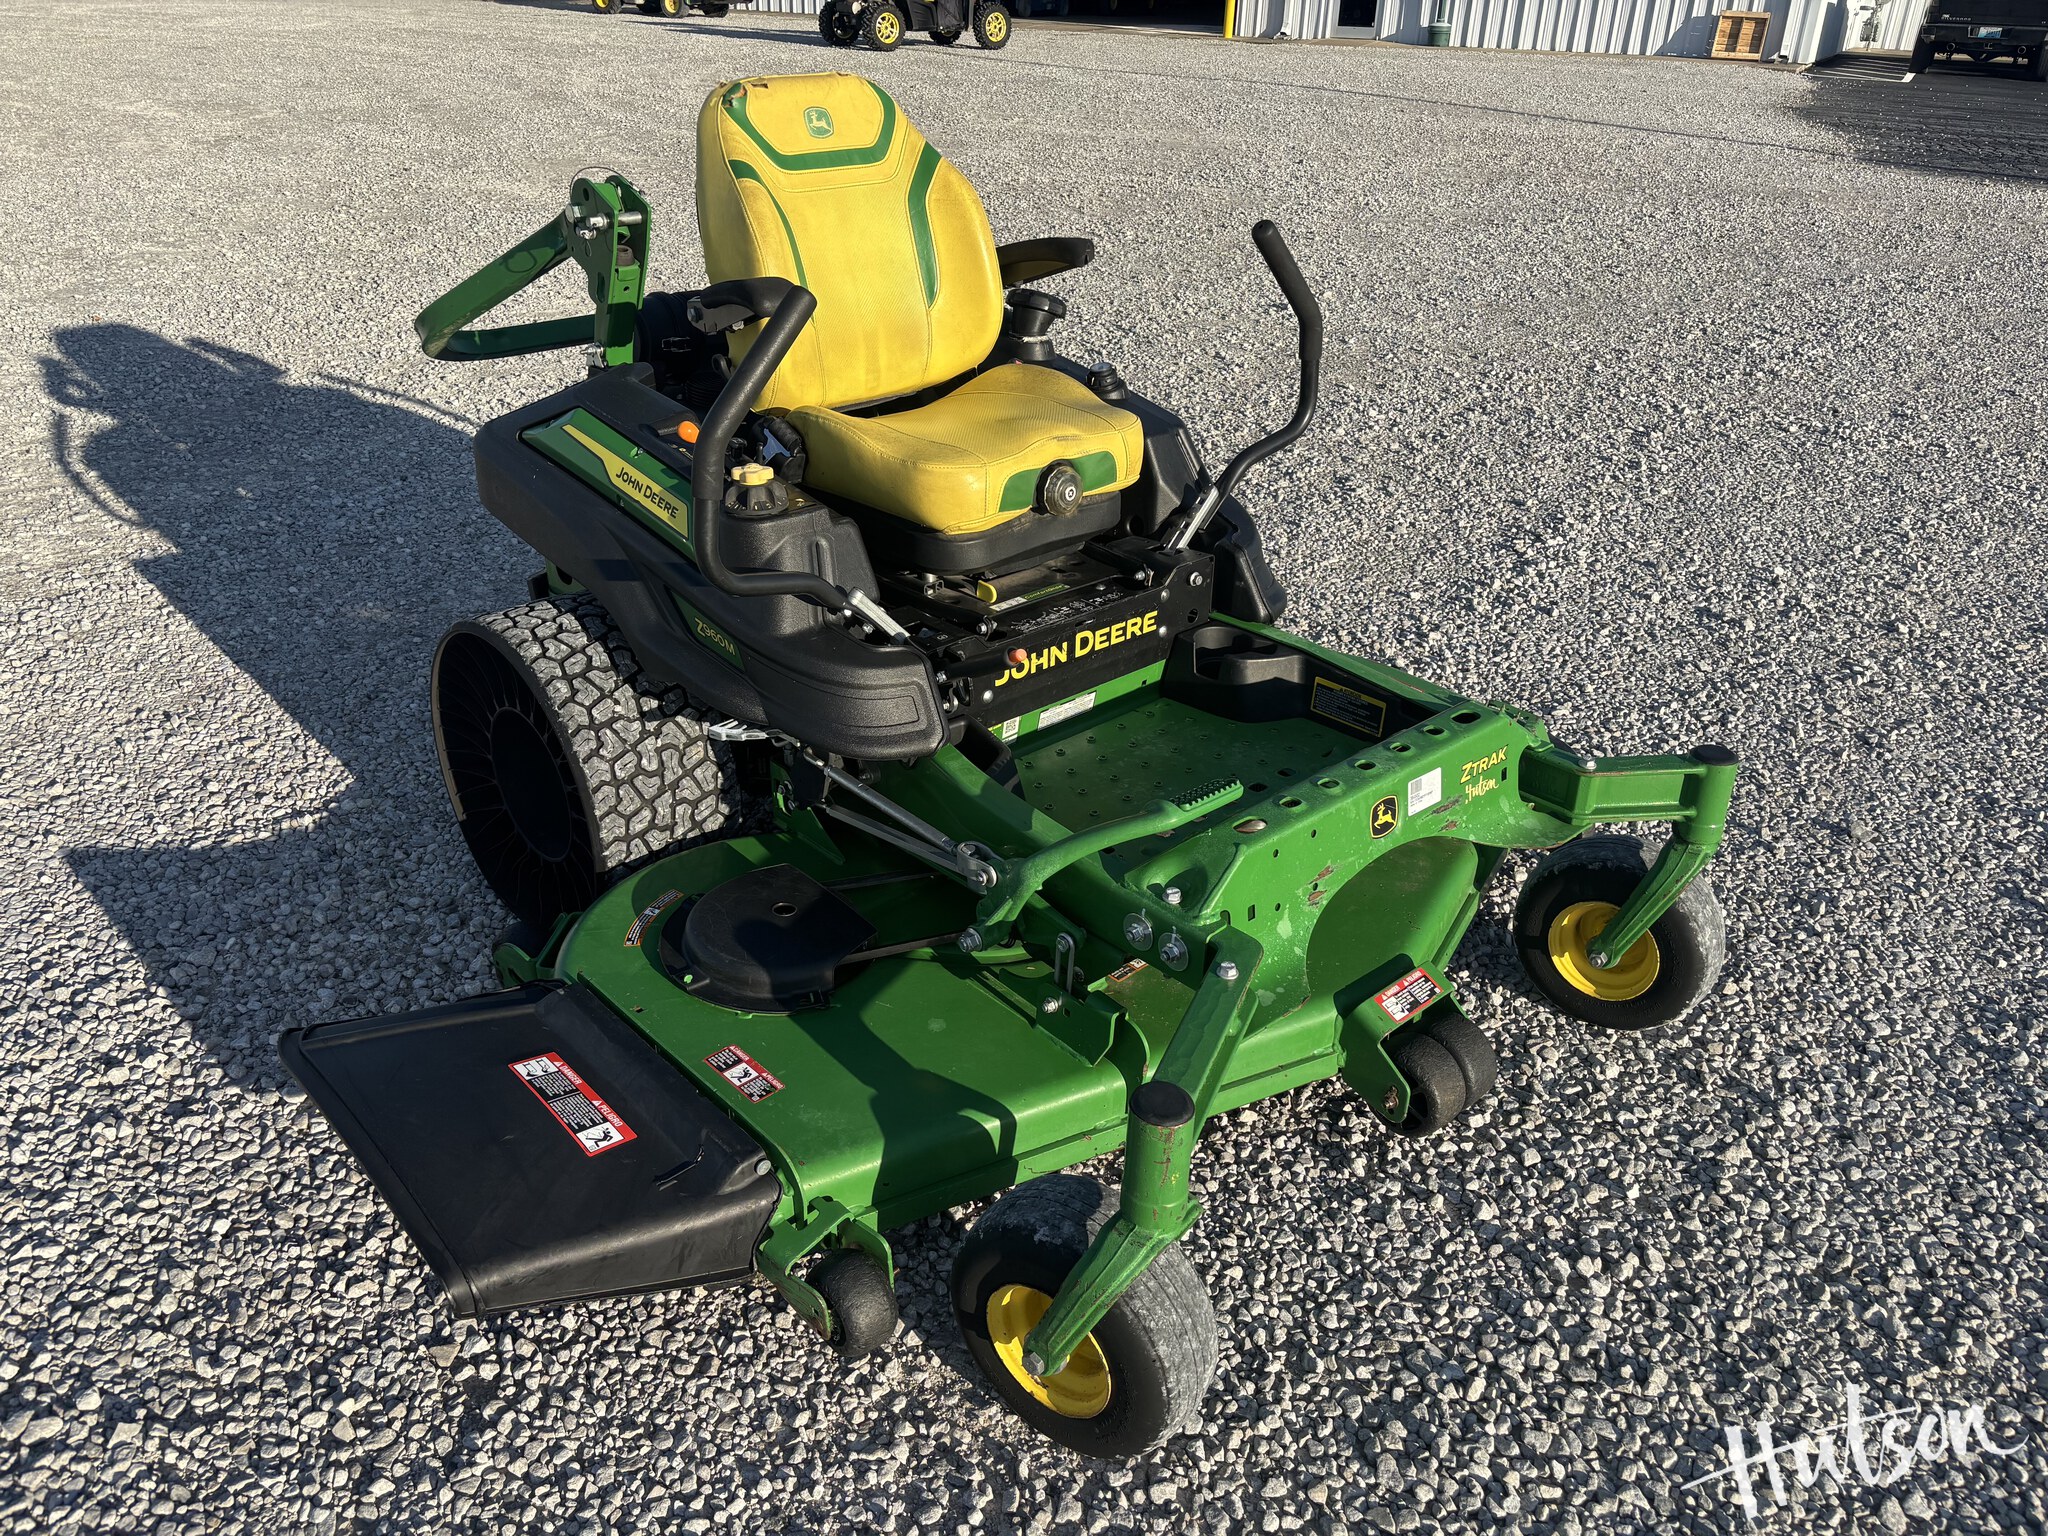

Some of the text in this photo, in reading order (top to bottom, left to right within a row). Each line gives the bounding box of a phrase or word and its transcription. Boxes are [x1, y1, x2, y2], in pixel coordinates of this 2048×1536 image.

[615, 467, 679, 519] JOHN DEERE
[695, 617, 736, 656] Z960M
[1075, 610, 1158, 658] DEERE
[1460, 744, 1509, 785] ZTRAK
[560, 1065, 582, 1085] DANGER
[598, 1104, 623, 1127] PELIGRO
